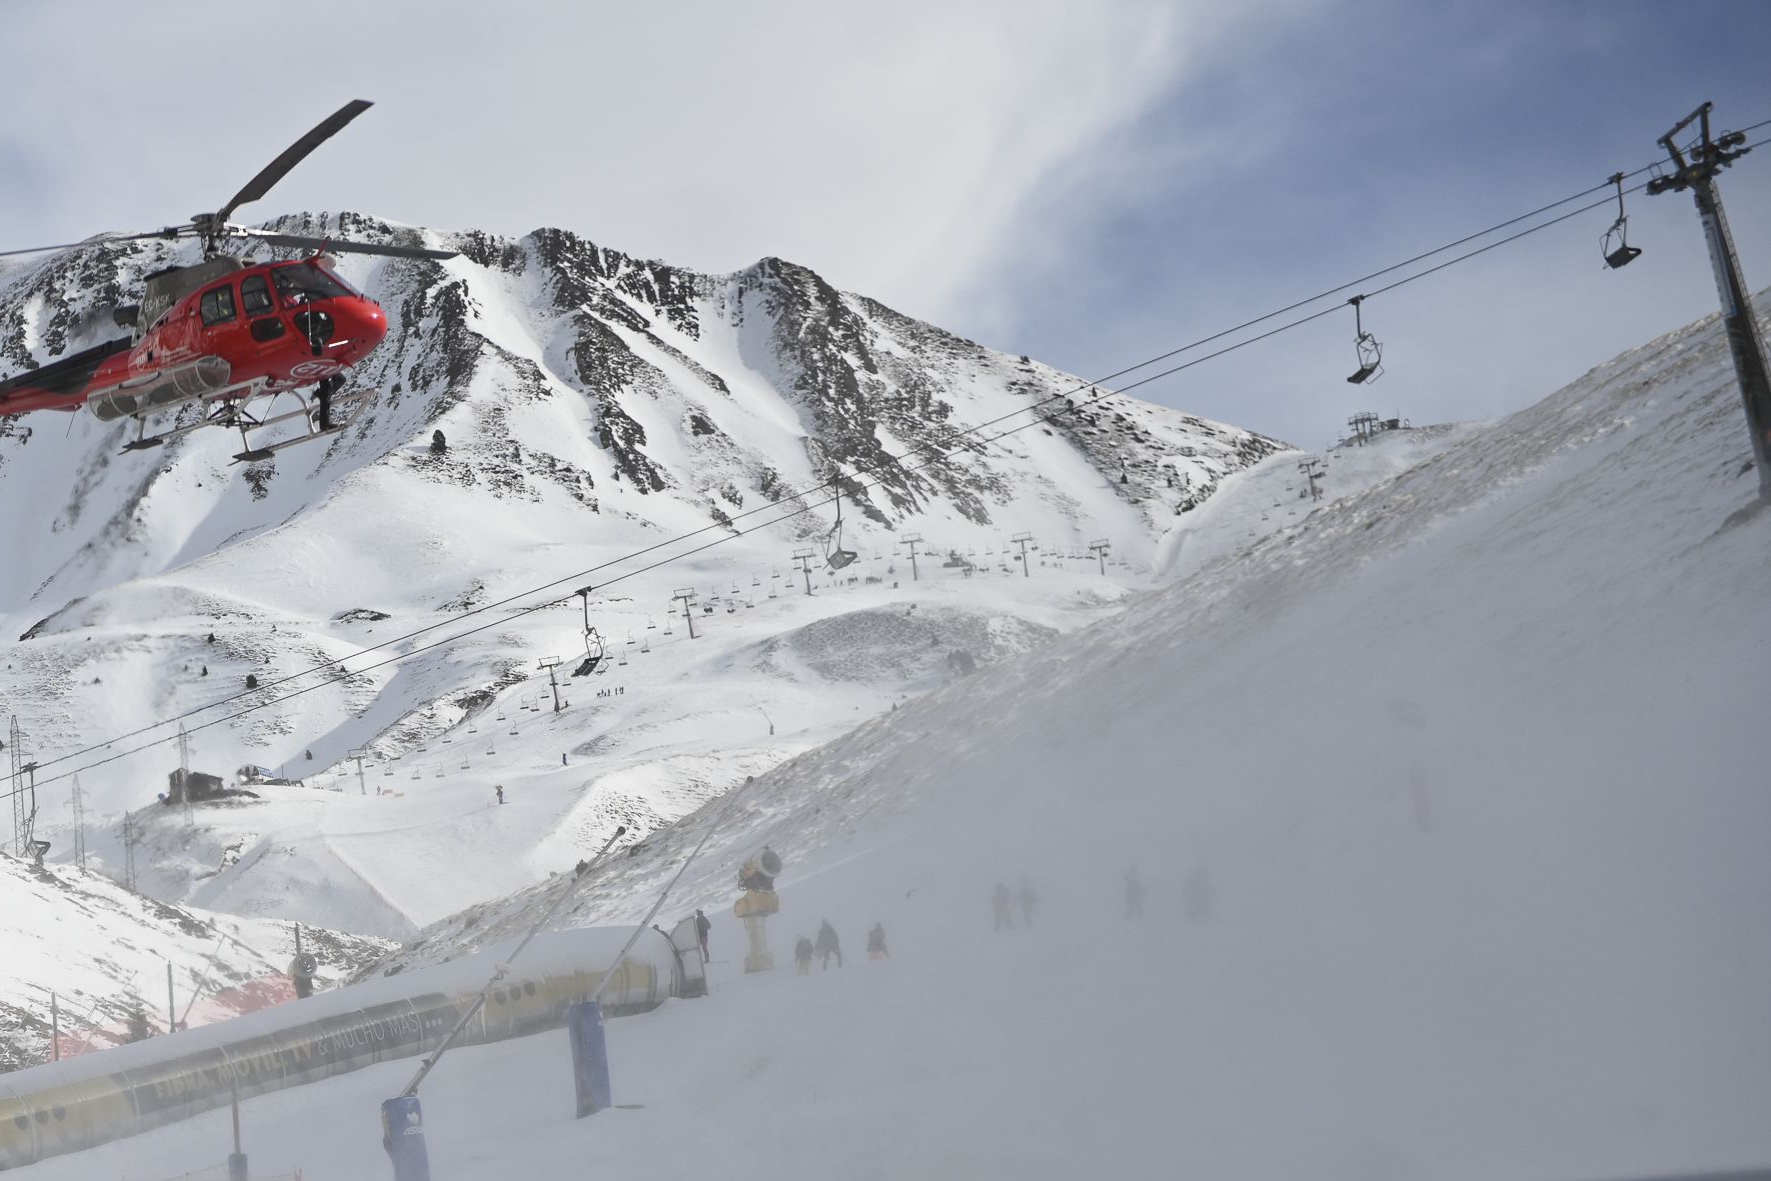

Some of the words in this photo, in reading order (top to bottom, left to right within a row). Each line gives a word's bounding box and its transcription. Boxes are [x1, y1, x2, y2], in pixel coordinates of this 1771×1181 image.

[291, 1037, 311, 1062] TV
[316, 1032, 330, 1055] &
[332, 1019, 384, 1049] MUCHO
